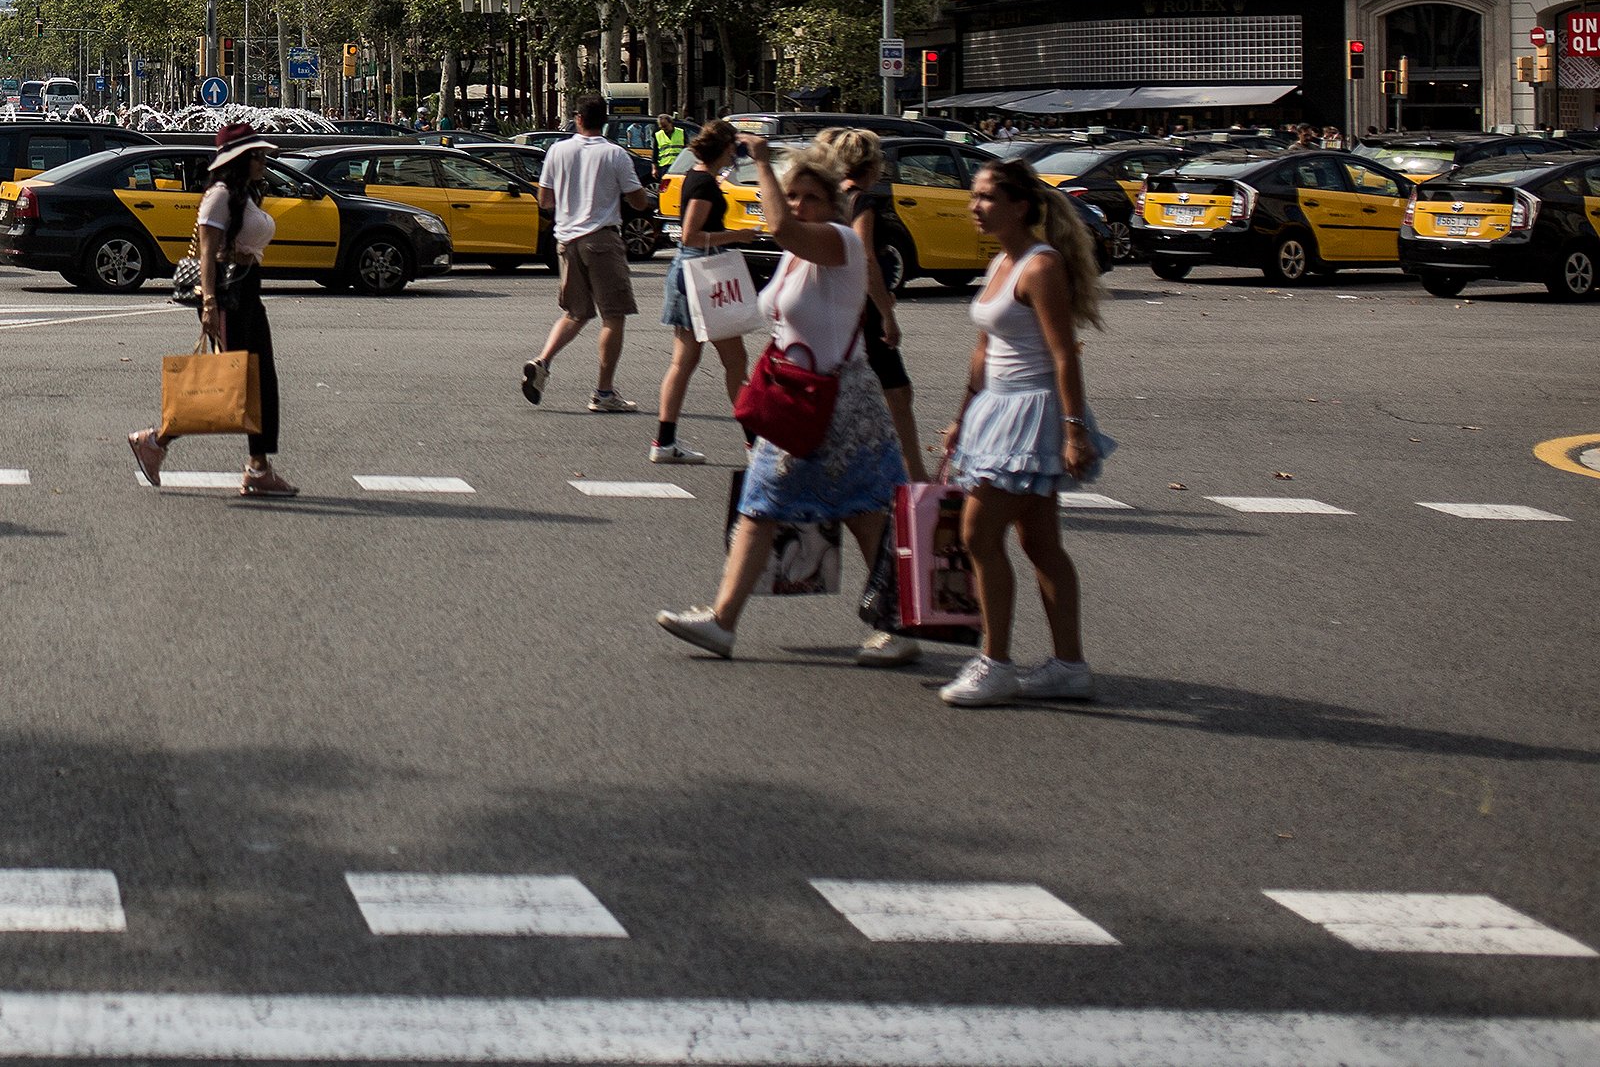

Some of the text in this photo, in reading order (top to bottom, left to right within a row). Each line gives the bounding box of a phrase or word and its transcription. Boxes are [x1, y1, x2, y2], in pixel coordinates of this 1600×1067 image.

[1572, 18, 1597, 34] UN
[1572, 36, 1600, 54] QL
[709, 278, 743, 308] H&M
